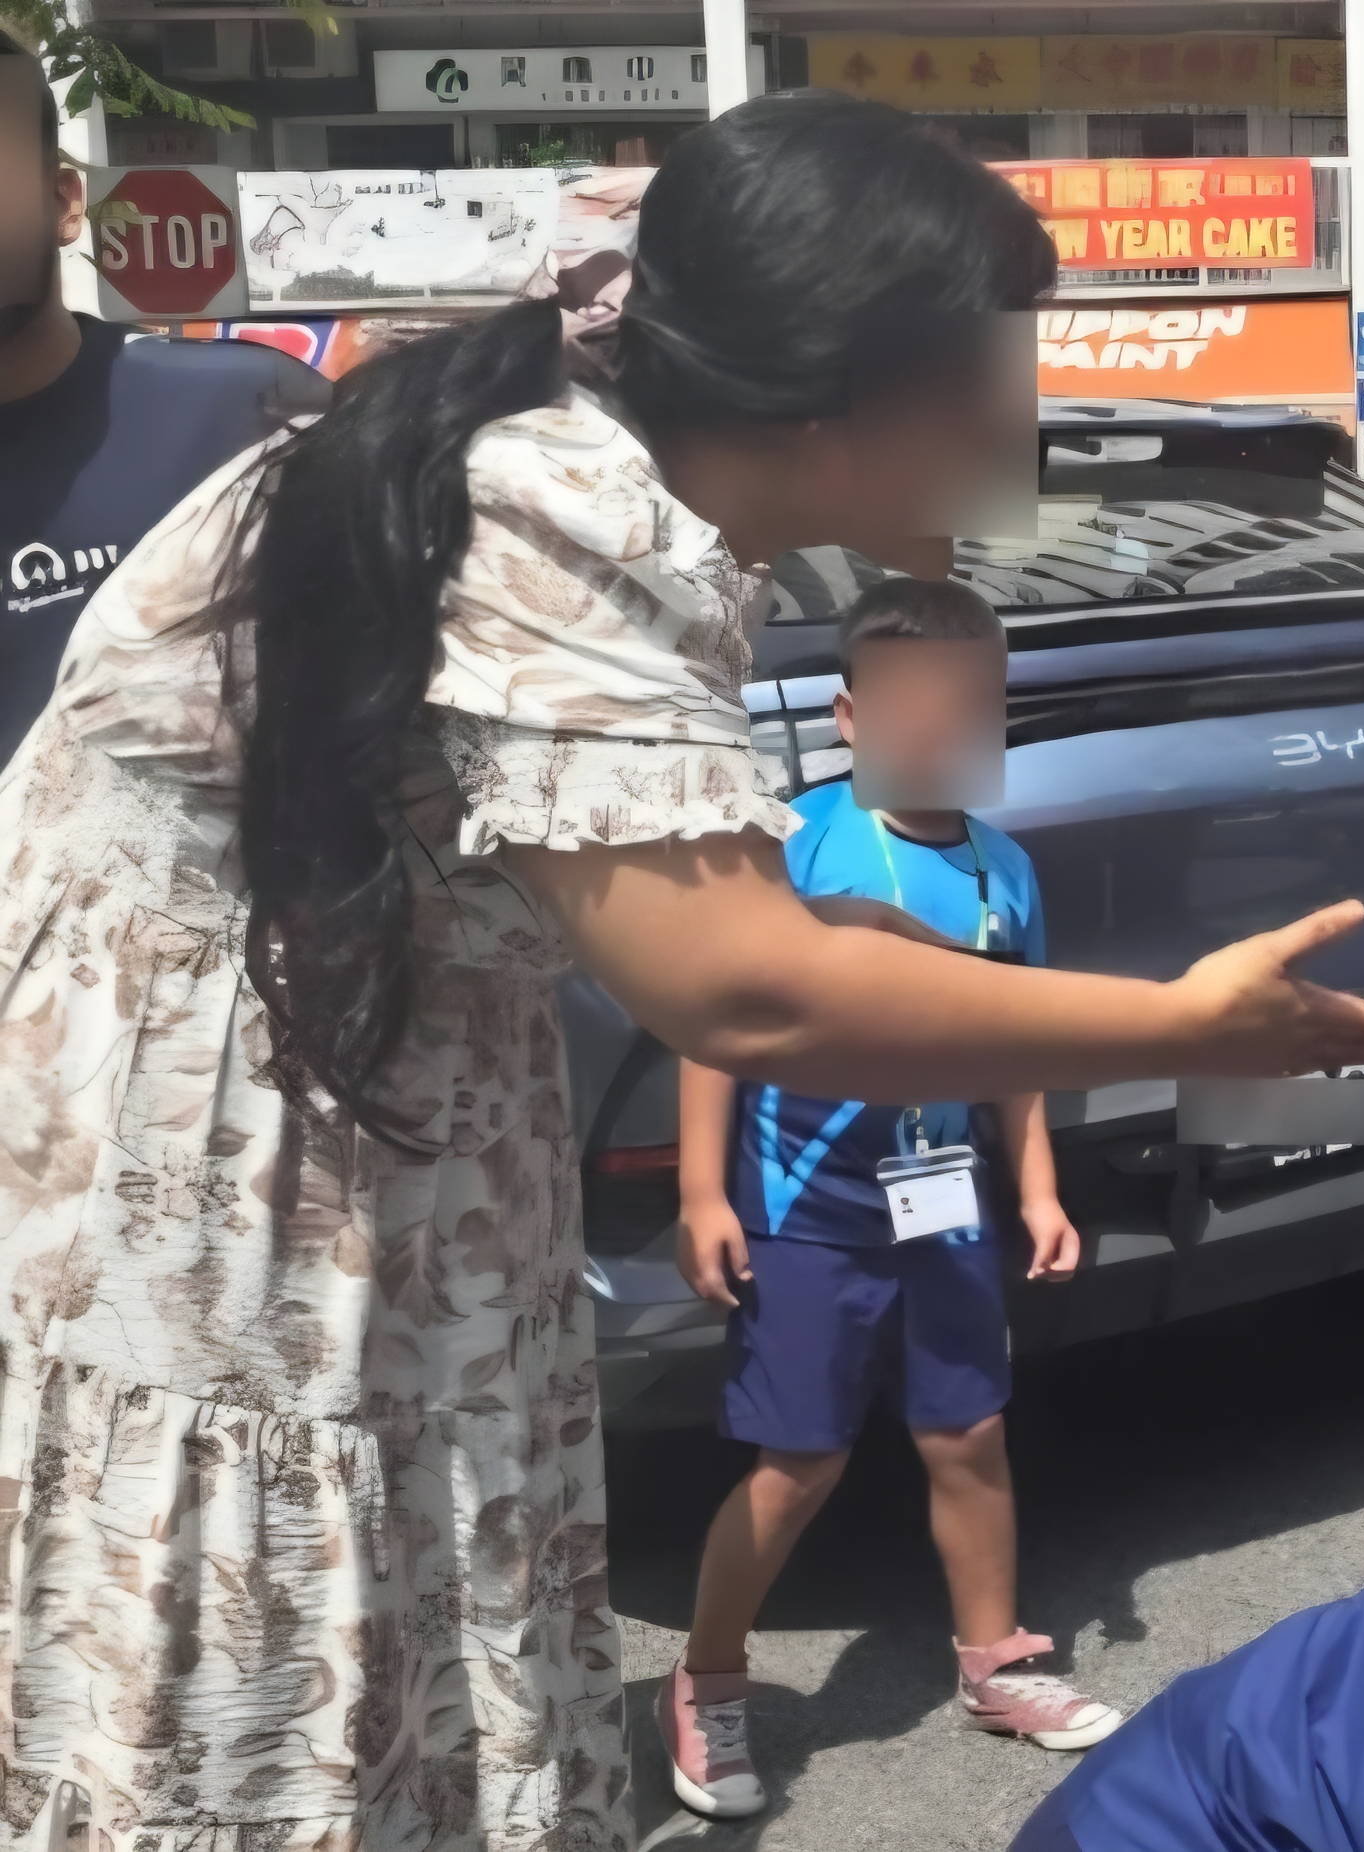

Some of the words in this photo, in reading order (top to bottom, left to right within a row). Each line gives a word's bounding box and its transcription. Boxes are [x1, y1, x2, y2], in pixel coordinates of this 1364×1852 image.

[101, 213, 227, 269] STOP
[1100, 219, 1192, 259] YEAR
[1203, 217, 1297, 257] CAKE
